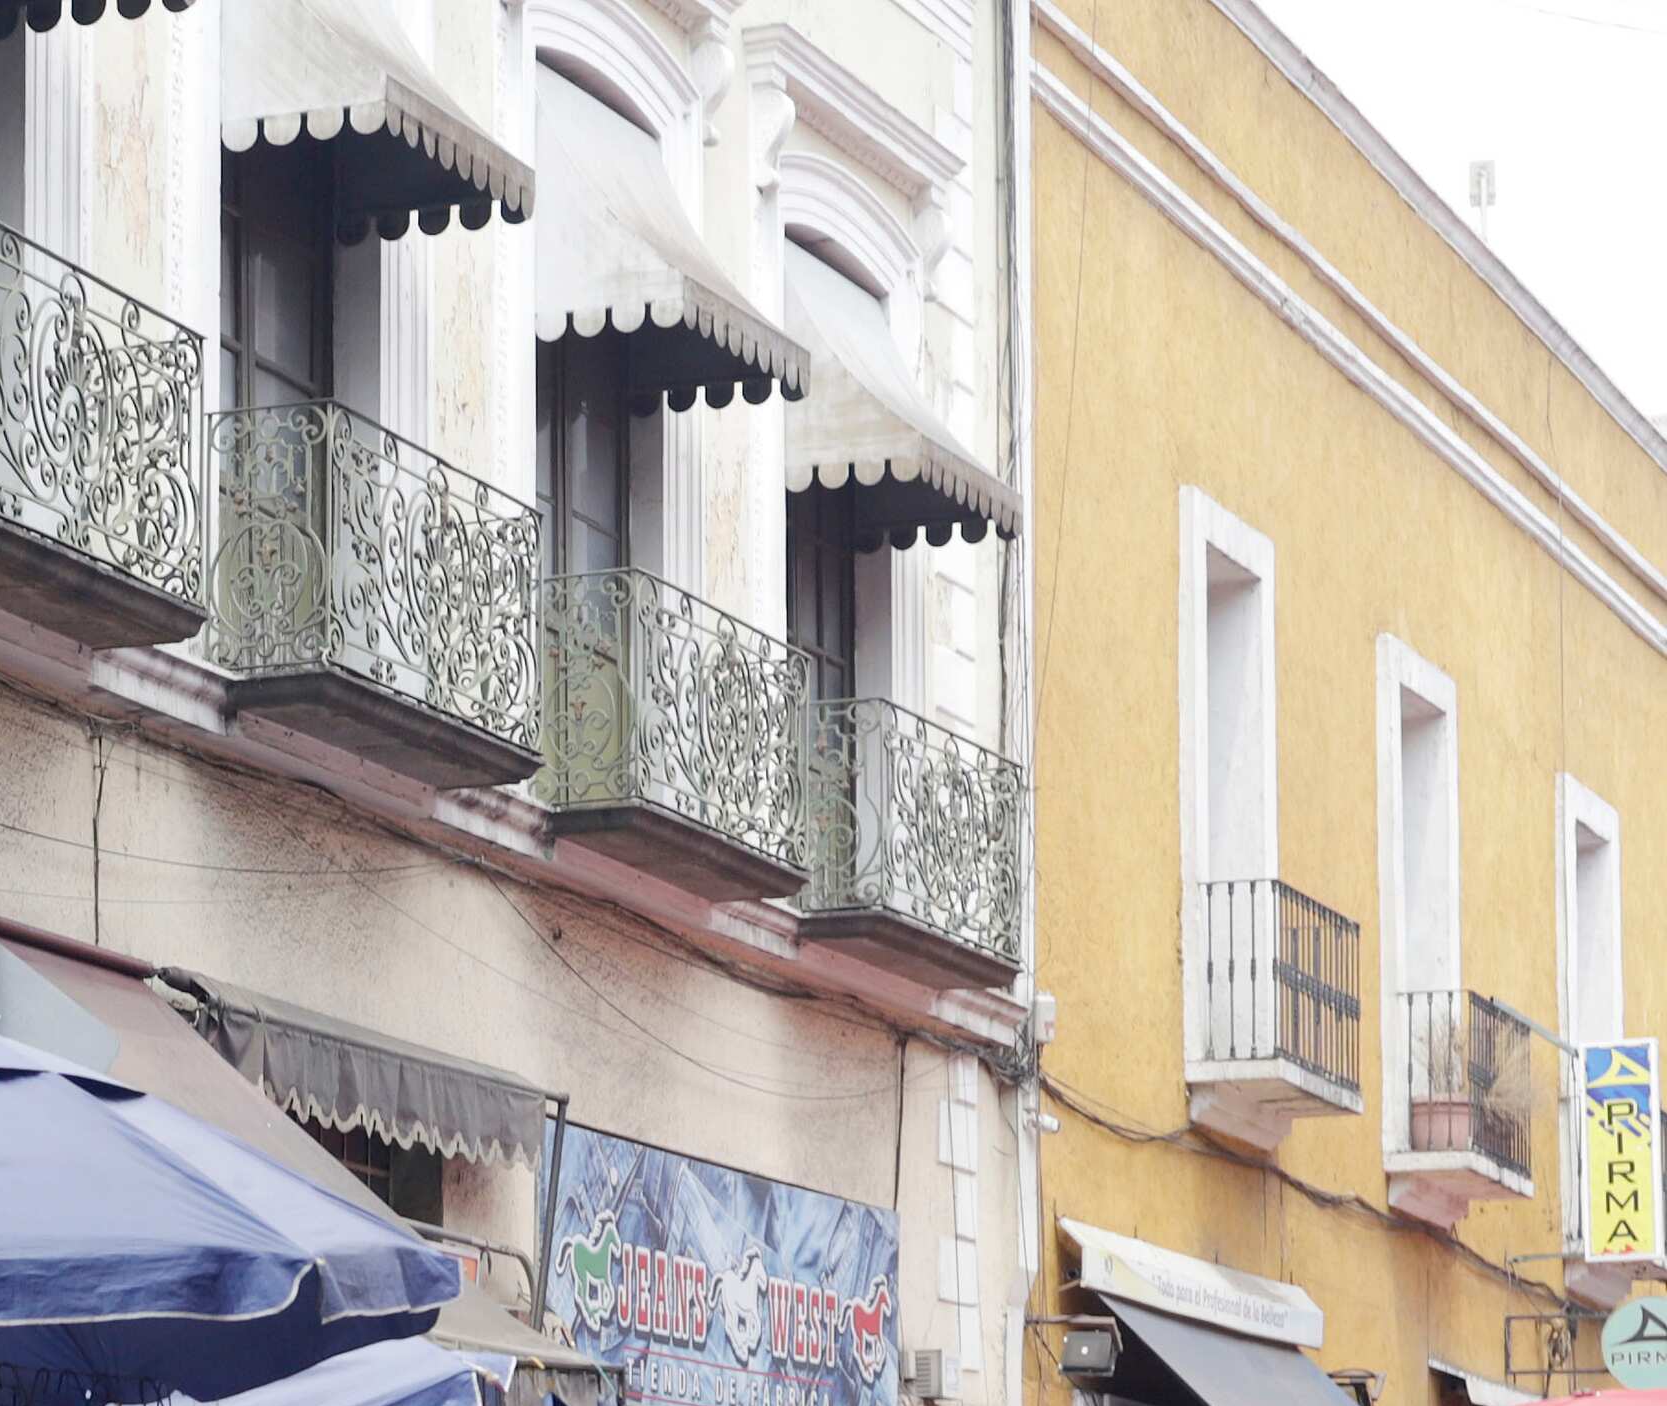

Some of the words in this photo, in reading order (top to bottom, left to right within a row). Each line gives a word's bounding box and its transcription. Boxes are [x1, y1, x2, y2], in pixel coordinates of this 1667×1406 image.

[1605, 1102, 1639, 1243] PIRMA
[767, 1277, 840, 1367] WEST
[627, 1358, 702, 1401] TIENDA
[1611, 1350, 1667, 1369] PIRM
